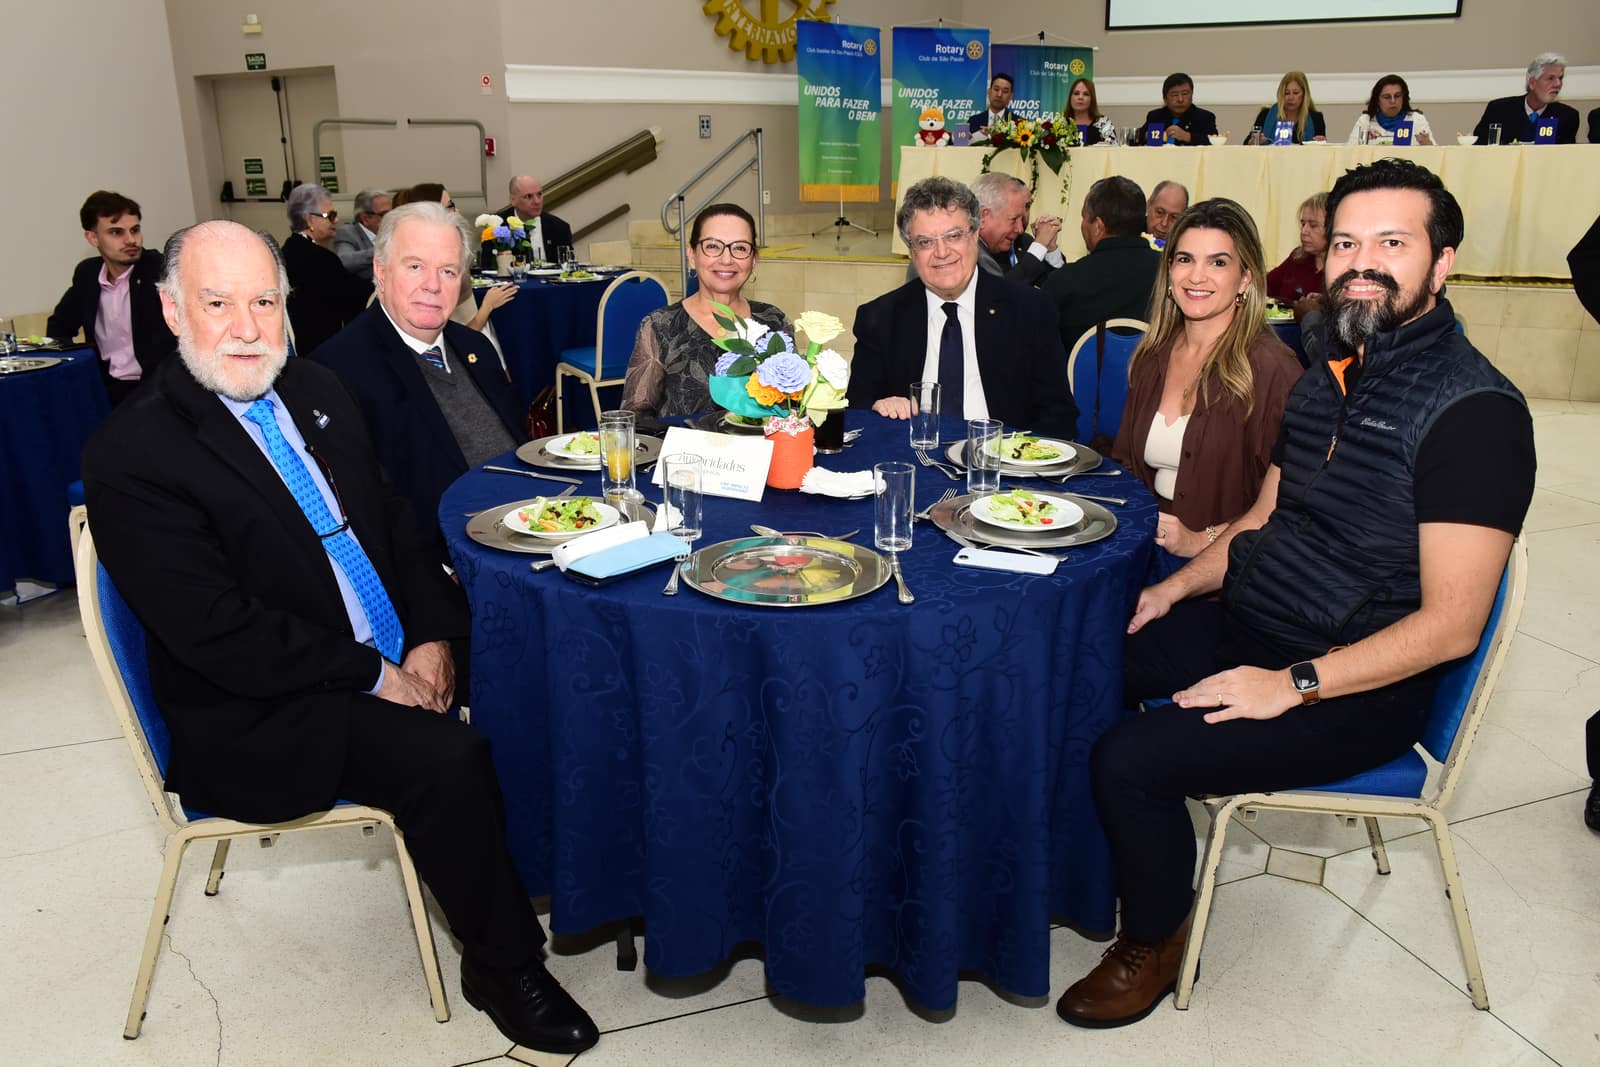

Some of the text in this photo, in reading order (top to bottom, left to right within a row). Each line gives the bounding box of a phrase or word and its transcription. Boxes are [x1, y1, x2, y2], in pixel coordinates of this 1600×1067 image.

[841, 40, 863, 51] Rotary
[935, 44, 964, 55] Rotary
[1044, 61, 1069, 72] Rotary
[804, 84, 841, 97] UNIDOS
[898, 87, 940, 98] UNIDOS
[815, 97, 870, 110] PARA FAZER
[910, 98, 973, 109] PARA FAZER
[1007, 99, 1040, 110] NIDOS
[848, 110, 877, 121] O BEM
[947, 110, 955, 120] O
[1151, 129, 1161, 139] 12
[1279, 128, 1289, 139] 10
[1397, 128, 1409, 138] 08
[1539, 126, 1553, 137] 06
